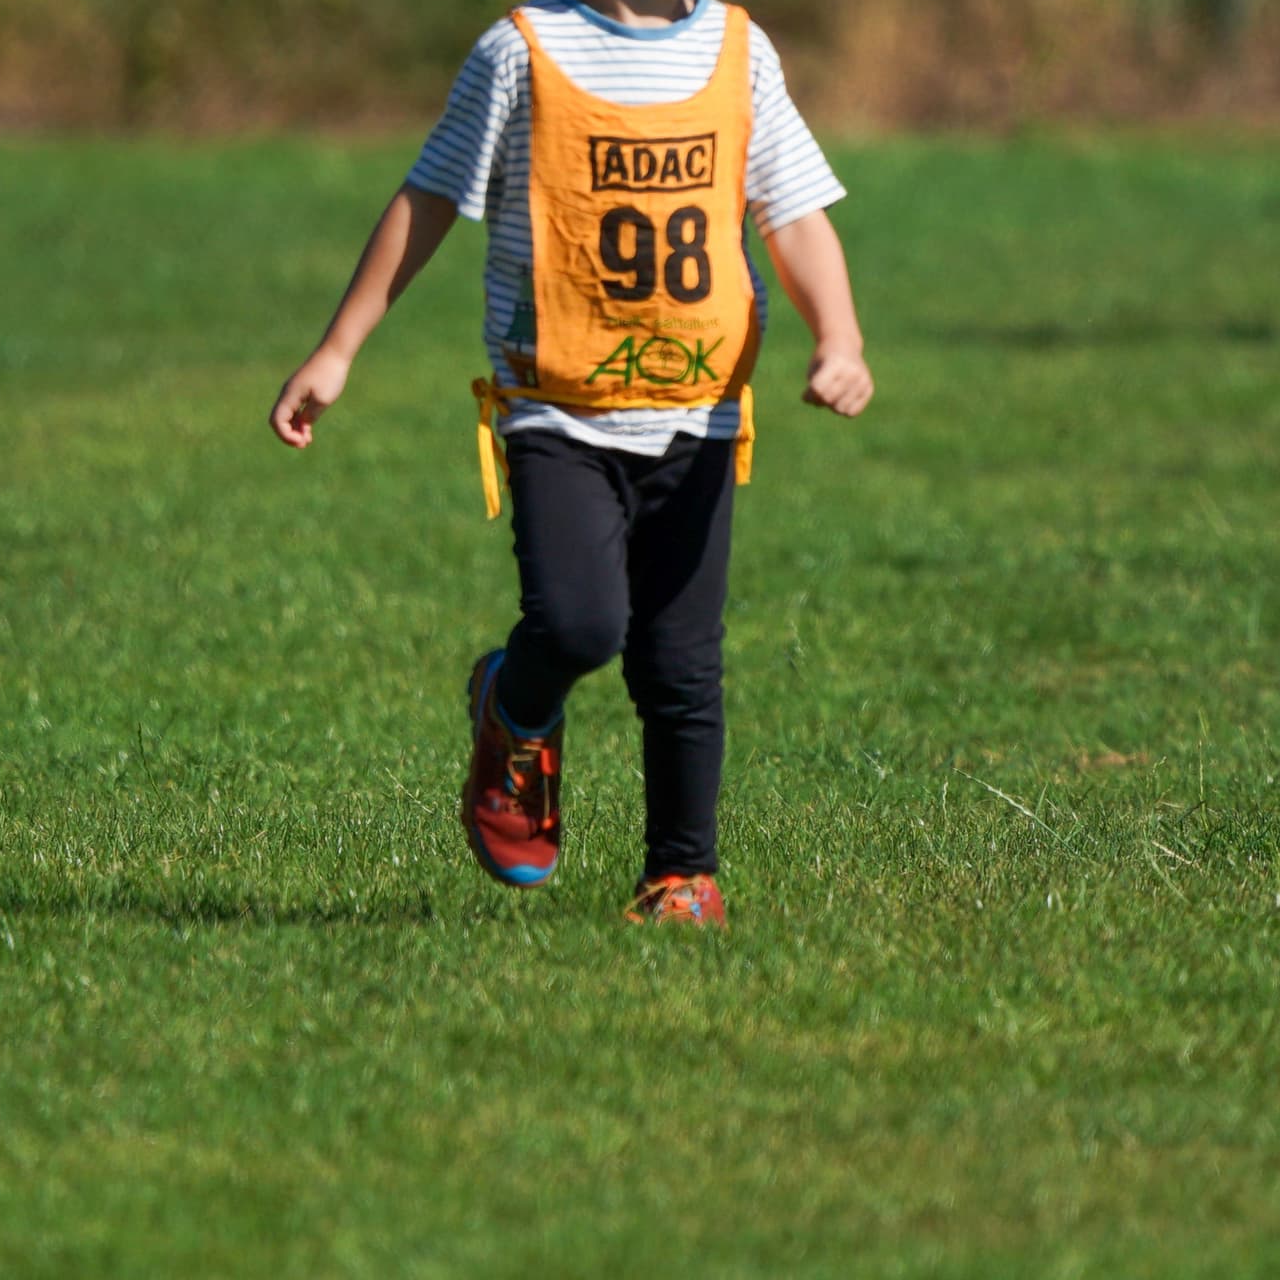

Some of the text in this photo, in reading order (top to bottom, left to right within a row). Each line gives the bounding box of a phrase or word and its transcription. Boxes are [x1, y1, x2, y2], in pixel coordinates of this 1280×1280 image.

[602, 145, 706, 183] ADAC
[599, 205, 712, 304] 98
[584, 335, 725, 387] AOK
